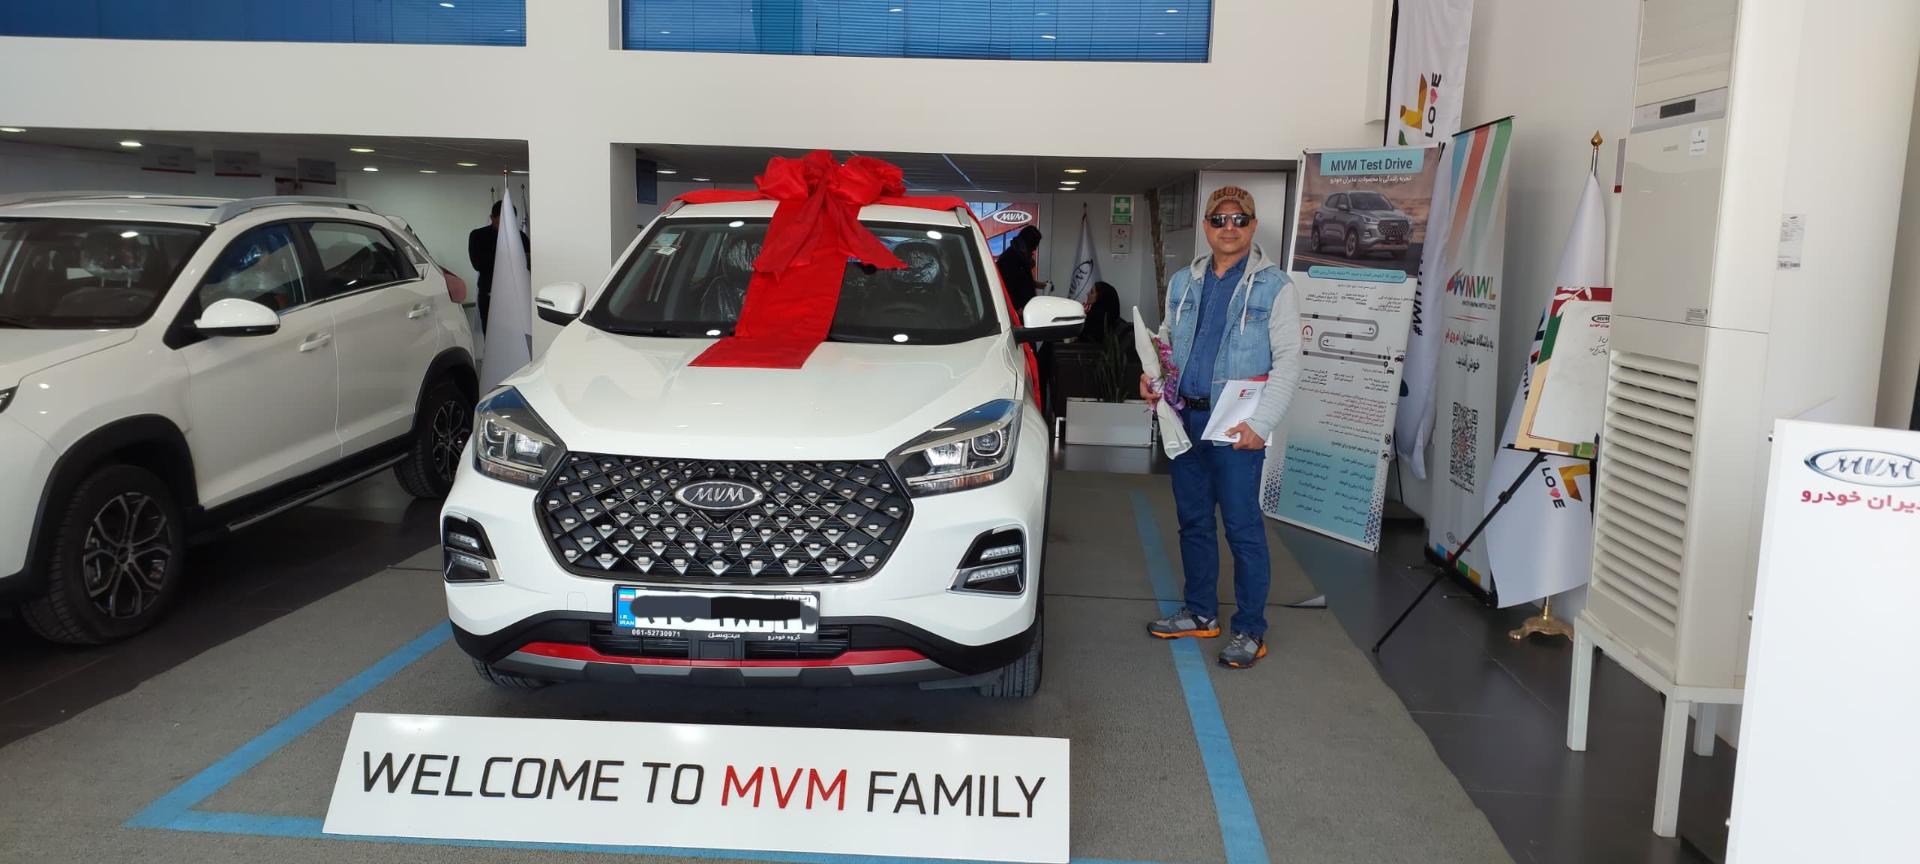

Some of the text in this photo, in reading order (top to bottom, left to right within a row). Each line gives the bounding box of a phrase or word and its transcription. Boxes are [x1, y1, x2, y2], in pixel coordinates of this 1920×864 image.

[1330, 157, 1413, 171] MVM Test Drive
[1000, 211, 1027, 222] MVM
[690, 487, 745, 502] MVM
[1801, 490, 1861, 506] خودرو
[363, 751, 1046, 819] WELCOME TO MVM FAMILY
